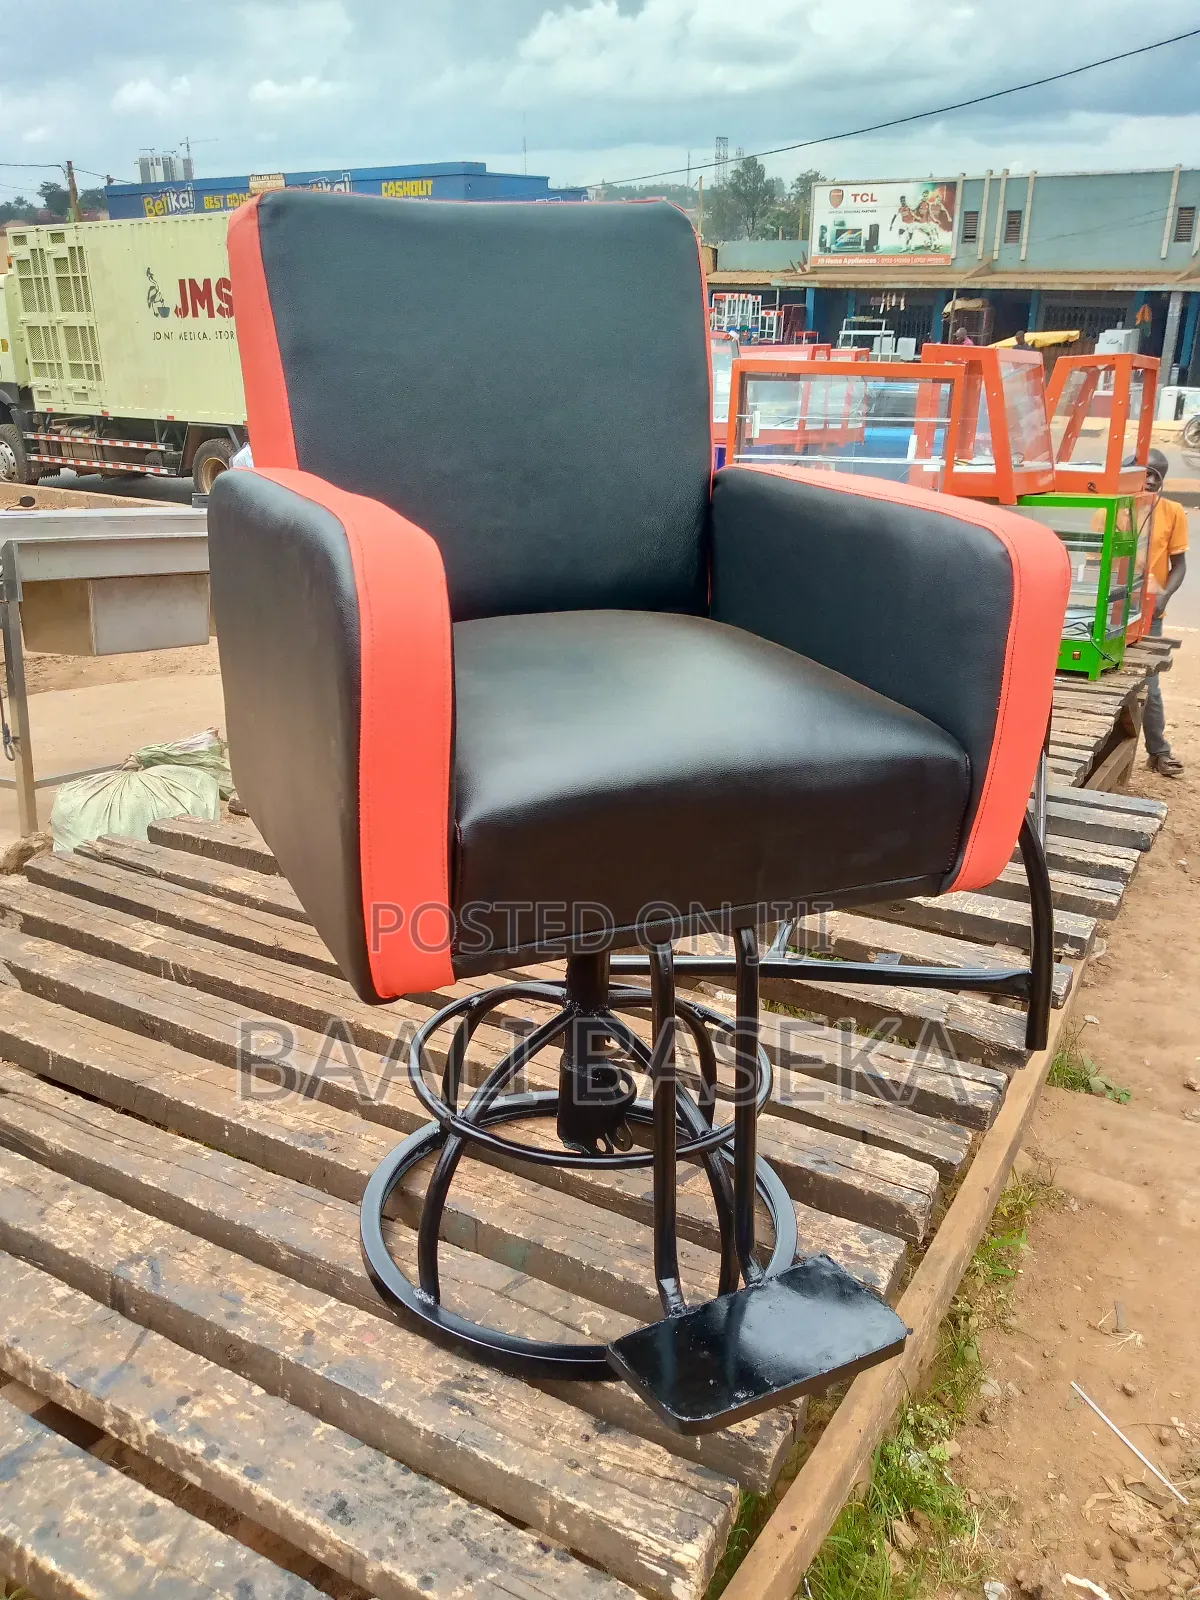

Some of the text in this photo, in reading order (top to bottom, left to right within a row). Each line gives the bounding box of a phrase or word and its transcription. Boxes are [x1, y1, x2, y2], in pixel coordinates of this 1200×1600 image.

[381, 180, 433, 197] CASHOUT
[203, 195, 224, 209] BEST
[851, 192, 878, 203] TCL
[843, 257, 877, 265] Appliances
[174, 277, 234, 318] JMS
[153, 331, 174, 341] JONT
